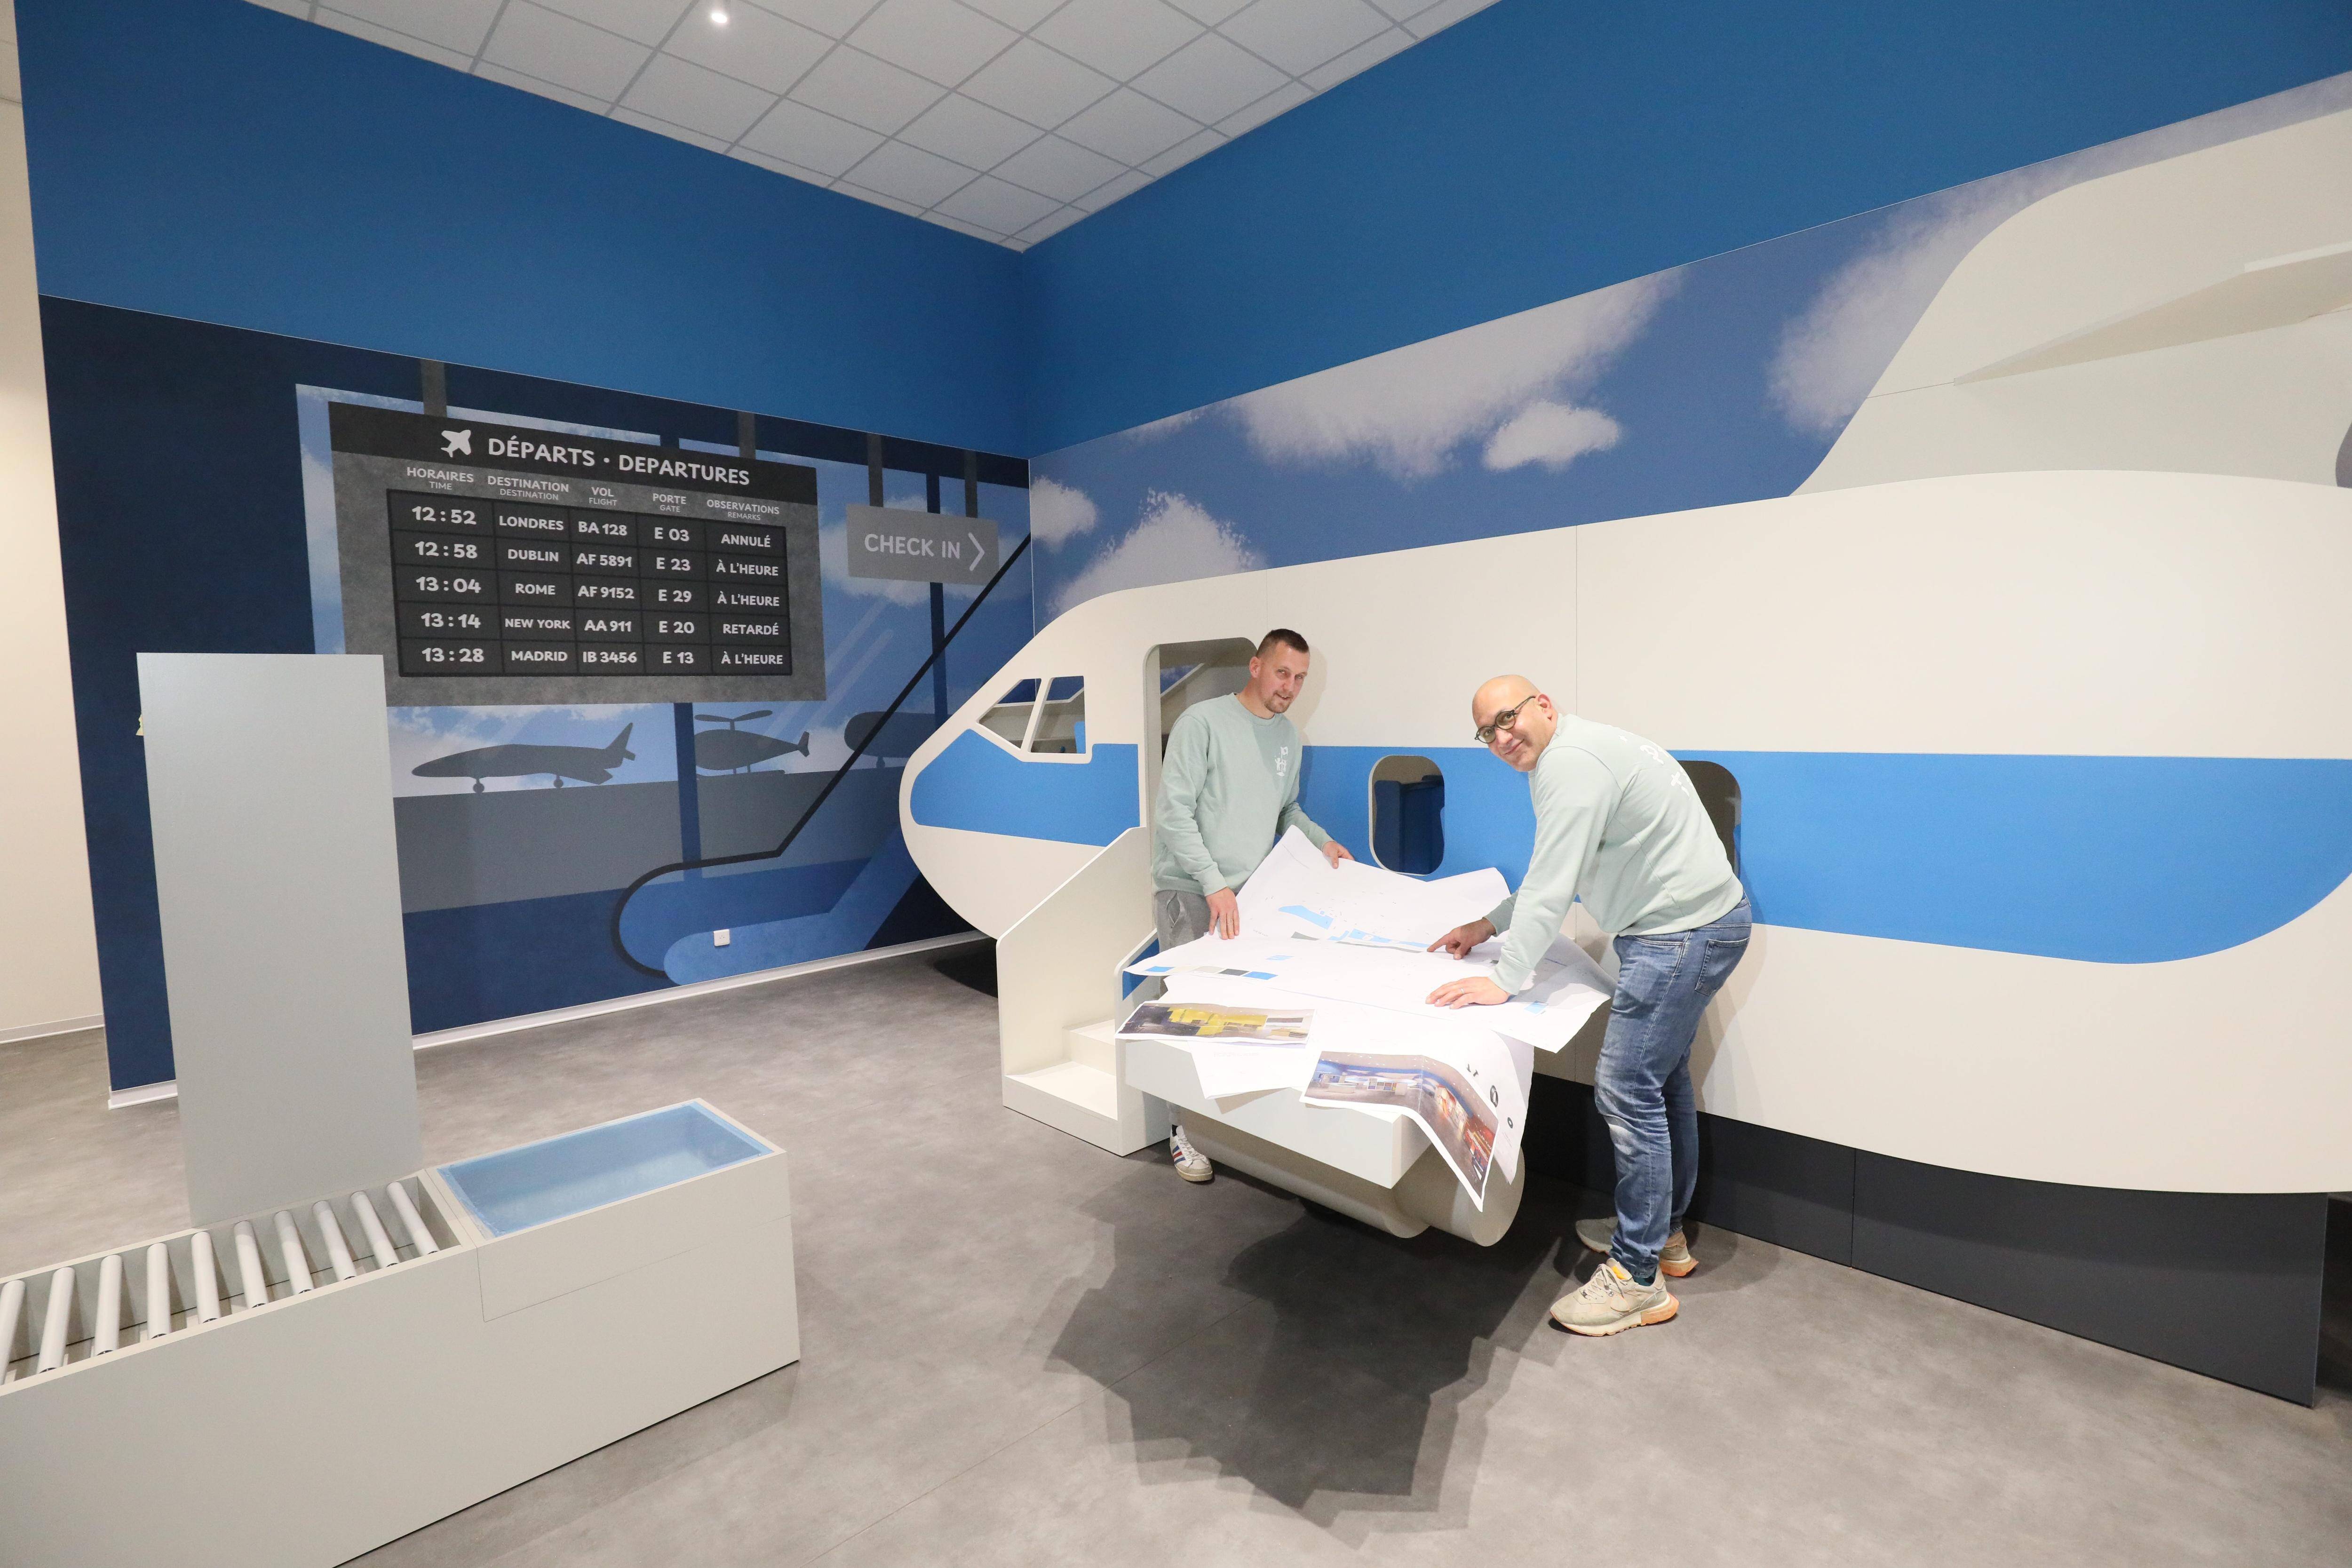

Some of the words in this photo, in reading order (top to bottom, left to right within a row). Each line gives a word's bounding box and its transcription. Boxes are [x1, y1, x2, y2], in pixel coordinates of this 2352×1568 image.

[489, 435, 595, 466] DÉPARTS
[619, 455, 749, 485] DEPARTURES
[407, 467, 474, 482] HORAIRES
[488, 476, 569, 493] DESTINATION
[591, 487, 614, 497] VOL
[653, 493, 686, 504] PORTE
[707, 500, 779, 515] OBSERVATIONS
[429, 481, 452, 490] TIME
[500, 489, 558, 500] DESTINATION
[728, 512, 761, 520] REMARKS
[499, 516, 564, 530] LONDRES
[579, 521, 600, 533] BA
[602, 524, 628, 536] 128
[654, 527, 663, 539] E
[669, 528, 690, 541] 03
[721, 534, 771, 547] ANNULÉ
[865, 533, 934, 557] CHECK
[942, 541, 960, 559] IN
[508, 549, 559, 562] DUBLIN
[576, 553, 596, 565] AF
[600, 555, 632, 567] 5891
[656, 557, 665, 569] E
[671, 558, 691, 571] 23
[716, 559, 726, 573] À
[516, 583, 556, 595] ROME
[578, 585, 597, 597] AF
[600, 587, 635, 599] 9152
[659, 589, 667, 601] E
[673, 590, 692, 602] 29
[717, 591, 727, 604] À
[505, 618, 533, 628] NEW
[537, 620, 571, 629] YORK
[584, 620, 607, 631] AA
[610, 621, 631, 632] 911
[659, 621, 668, 633] E
[673, 621, 694, 634] 20
[723, 622, 779, 635] RETARDÉ
[511, 651, 568, 661] MADRID
[583, 652, 597, 662] IB
[600, 652, 637, 663] 3456
[663, 652, 672, 663] E
[677, 652, 694, 664] 13
[721, 651, 731, 664] À
